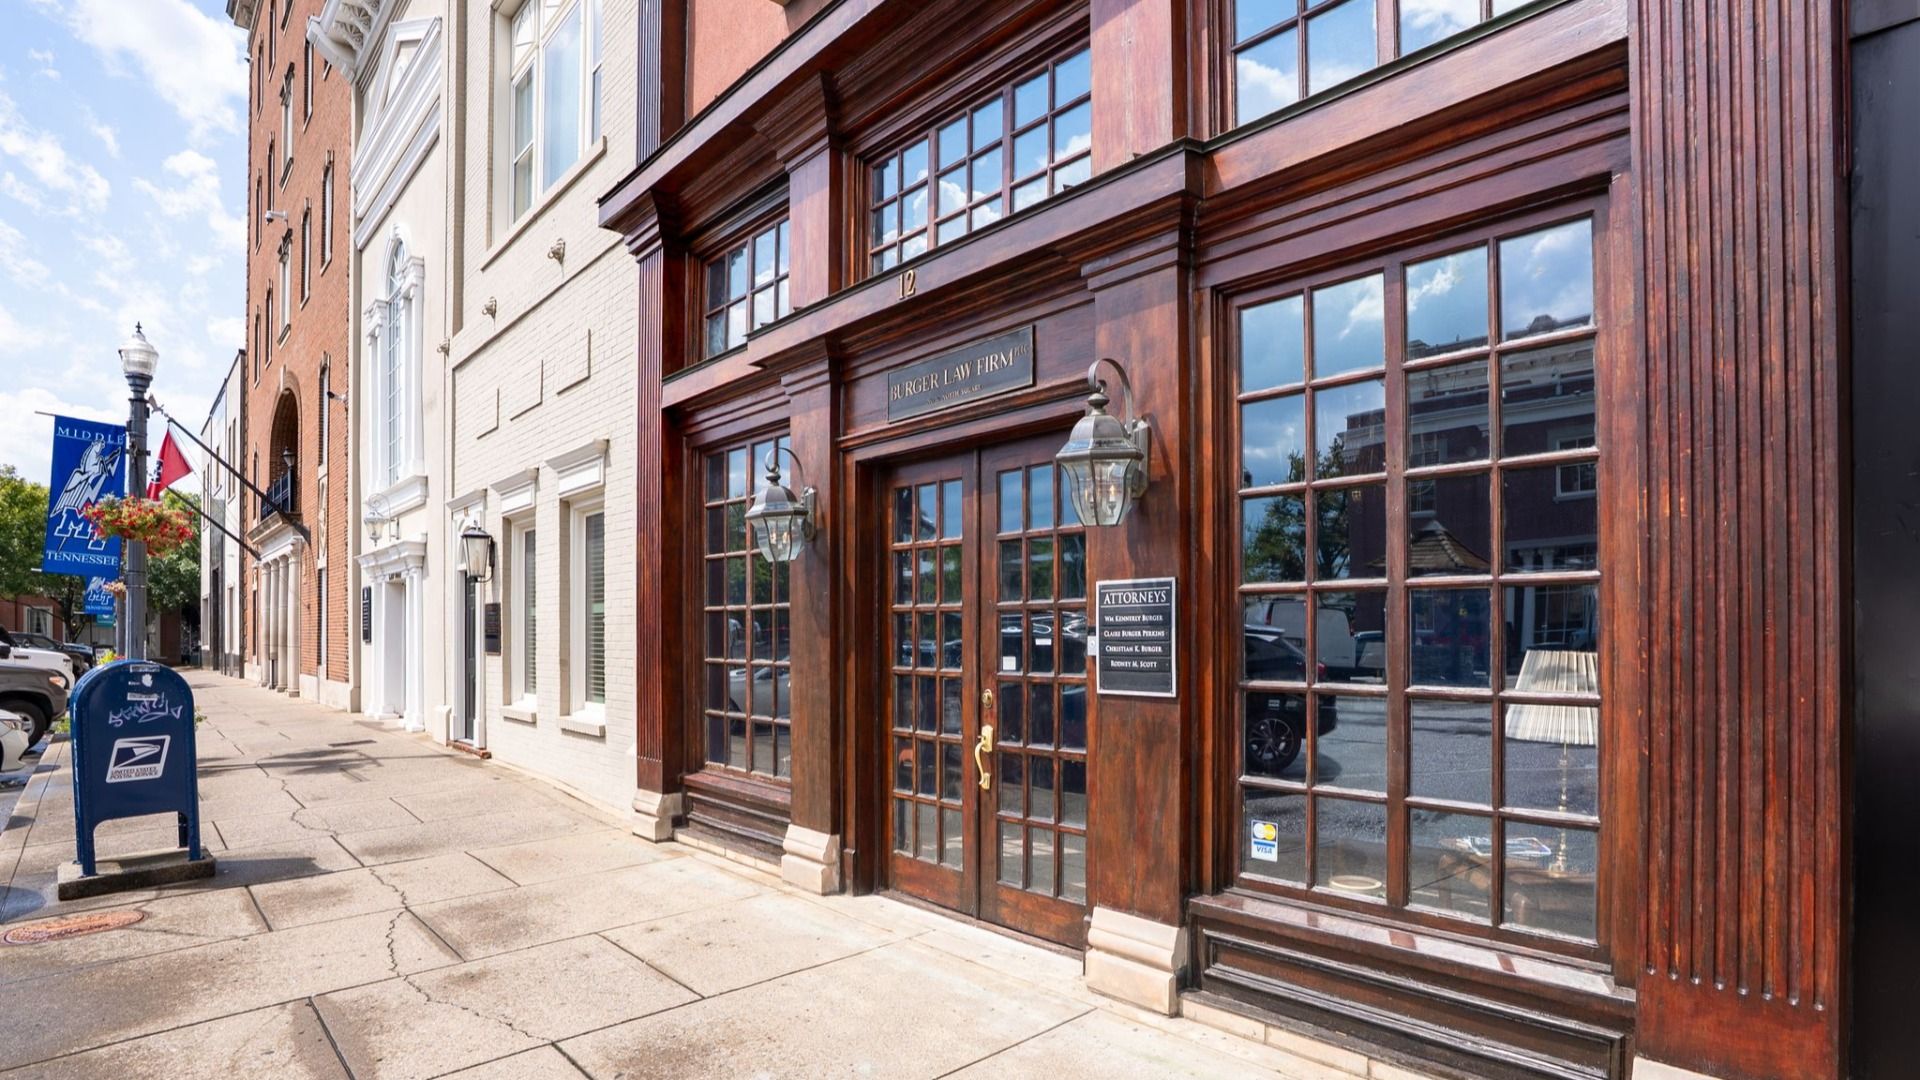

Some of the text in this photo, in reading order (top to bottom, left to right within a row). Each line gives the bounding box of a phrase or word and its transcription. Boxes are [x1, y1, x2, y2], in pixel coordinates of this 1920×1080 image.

[899, 270, 915, 298] 12
[890, 373, 939, 401] BURGER
[943, 361, 973, 386] LAW
[976, 348, 1014, 376] FIRM
[57, 426, 124, 445] MIDDLE
[46, 550, 119, 567] TENNESSEE
[1103, 590, 1167, 605] ATTORNEYS
[1142, 614, 1163, 622] BURGER
[1121, 630, 1142, 638] BURGER
[1142, 630, 1165, 638] PERKINS
[1139, 660, 1157, 668] SCOTT
[1256, 845, 1273, 854] VISA
